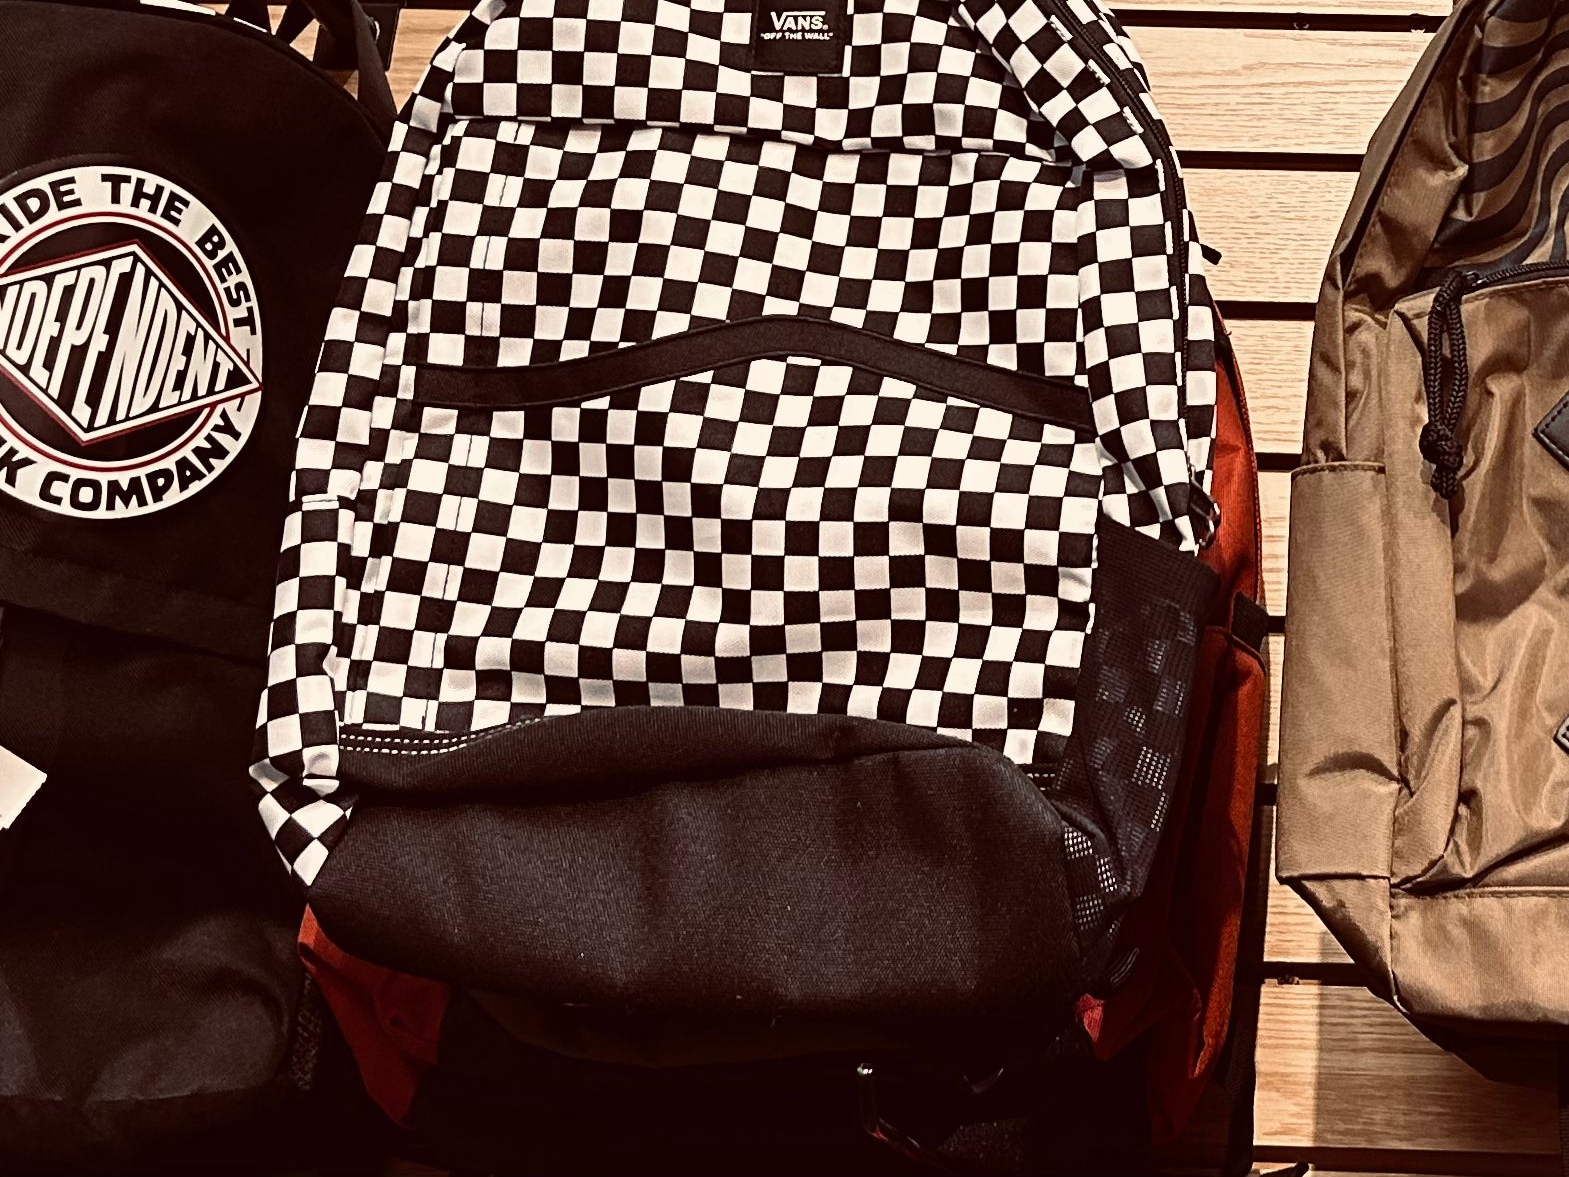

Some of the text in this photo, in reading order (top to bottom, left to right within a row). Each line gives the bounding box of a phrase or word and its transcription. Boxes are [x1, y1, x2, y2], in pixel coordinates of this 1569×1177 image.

[770, 10, 826, 31] VANS
[784, 31, 803, 40] THE
[0, 173, 257, 336] IDE THE BEST
[0, 255, 234, 429] DEPENDENT
[39, 407, 242, 512] COMPANY
